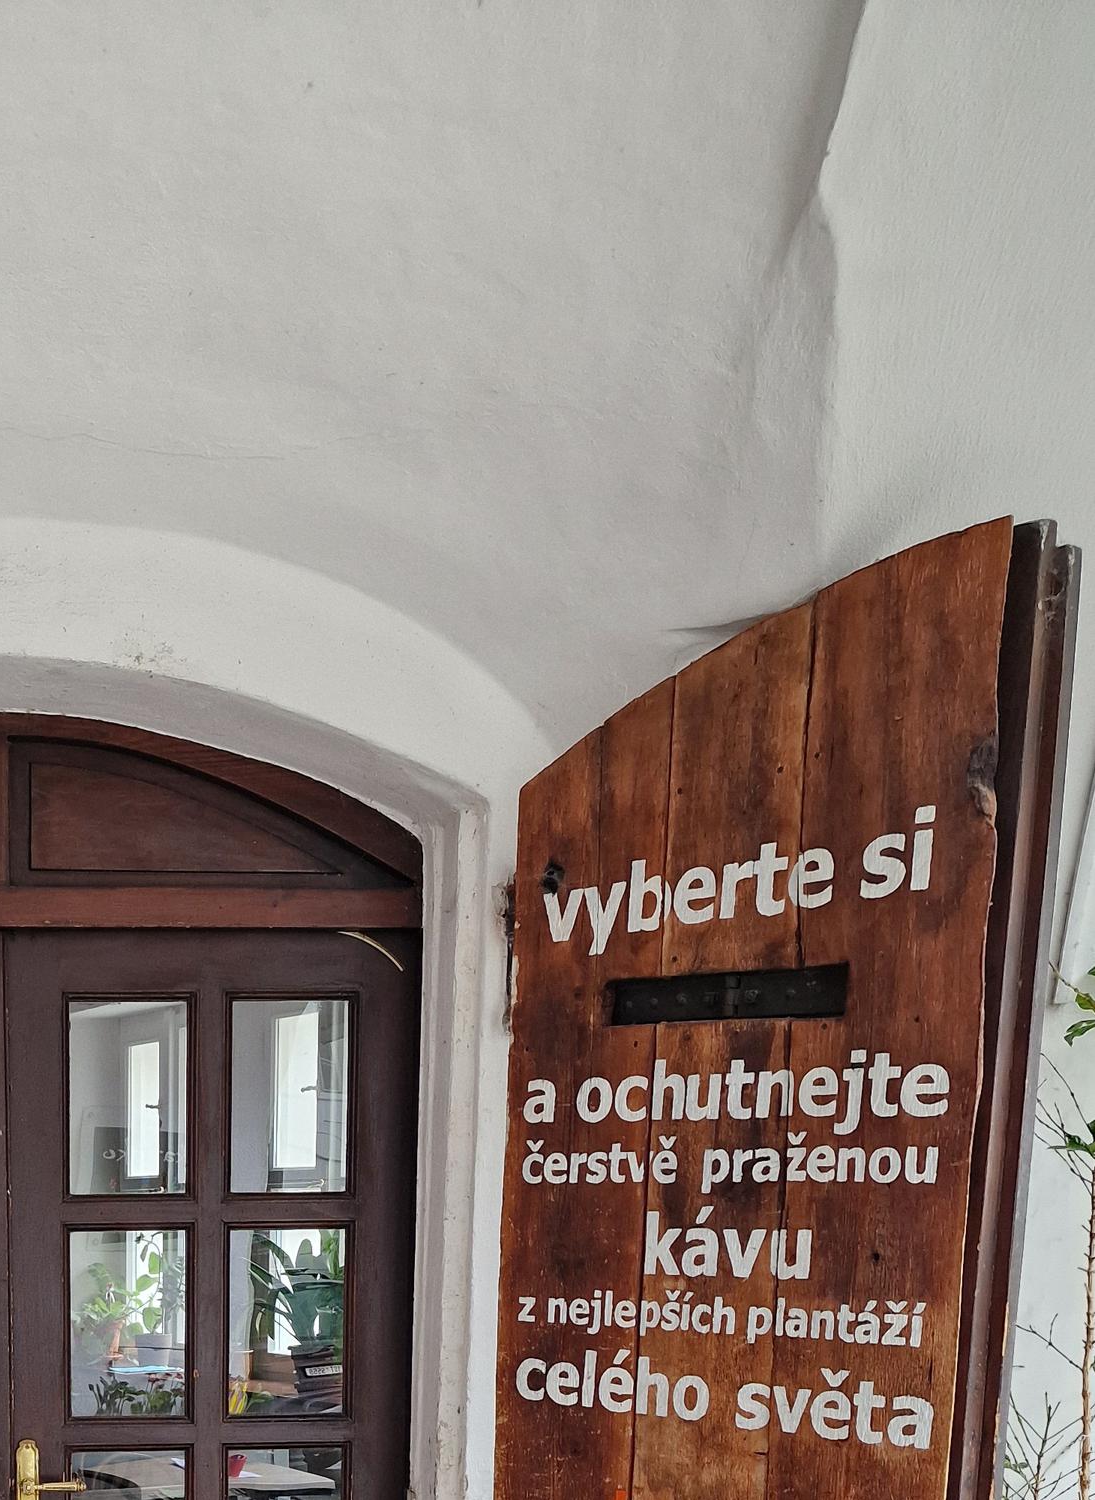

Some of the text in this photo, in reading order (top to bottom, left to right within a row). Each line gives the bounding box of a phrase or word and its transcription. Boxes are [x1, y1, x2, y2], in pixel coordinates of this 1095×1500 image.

[543, 804, 937, 956] vyberte si
[522, 1049, 950, 1136] a ochutnejte
[522, 1132, 939, 1194] čerstvě praženou
[643, 1205, 813, 1280] kávu
[517, 1289, 927, 1348] z nejlepších plantáží
[515, 1349, 936, 1451] celého světa
